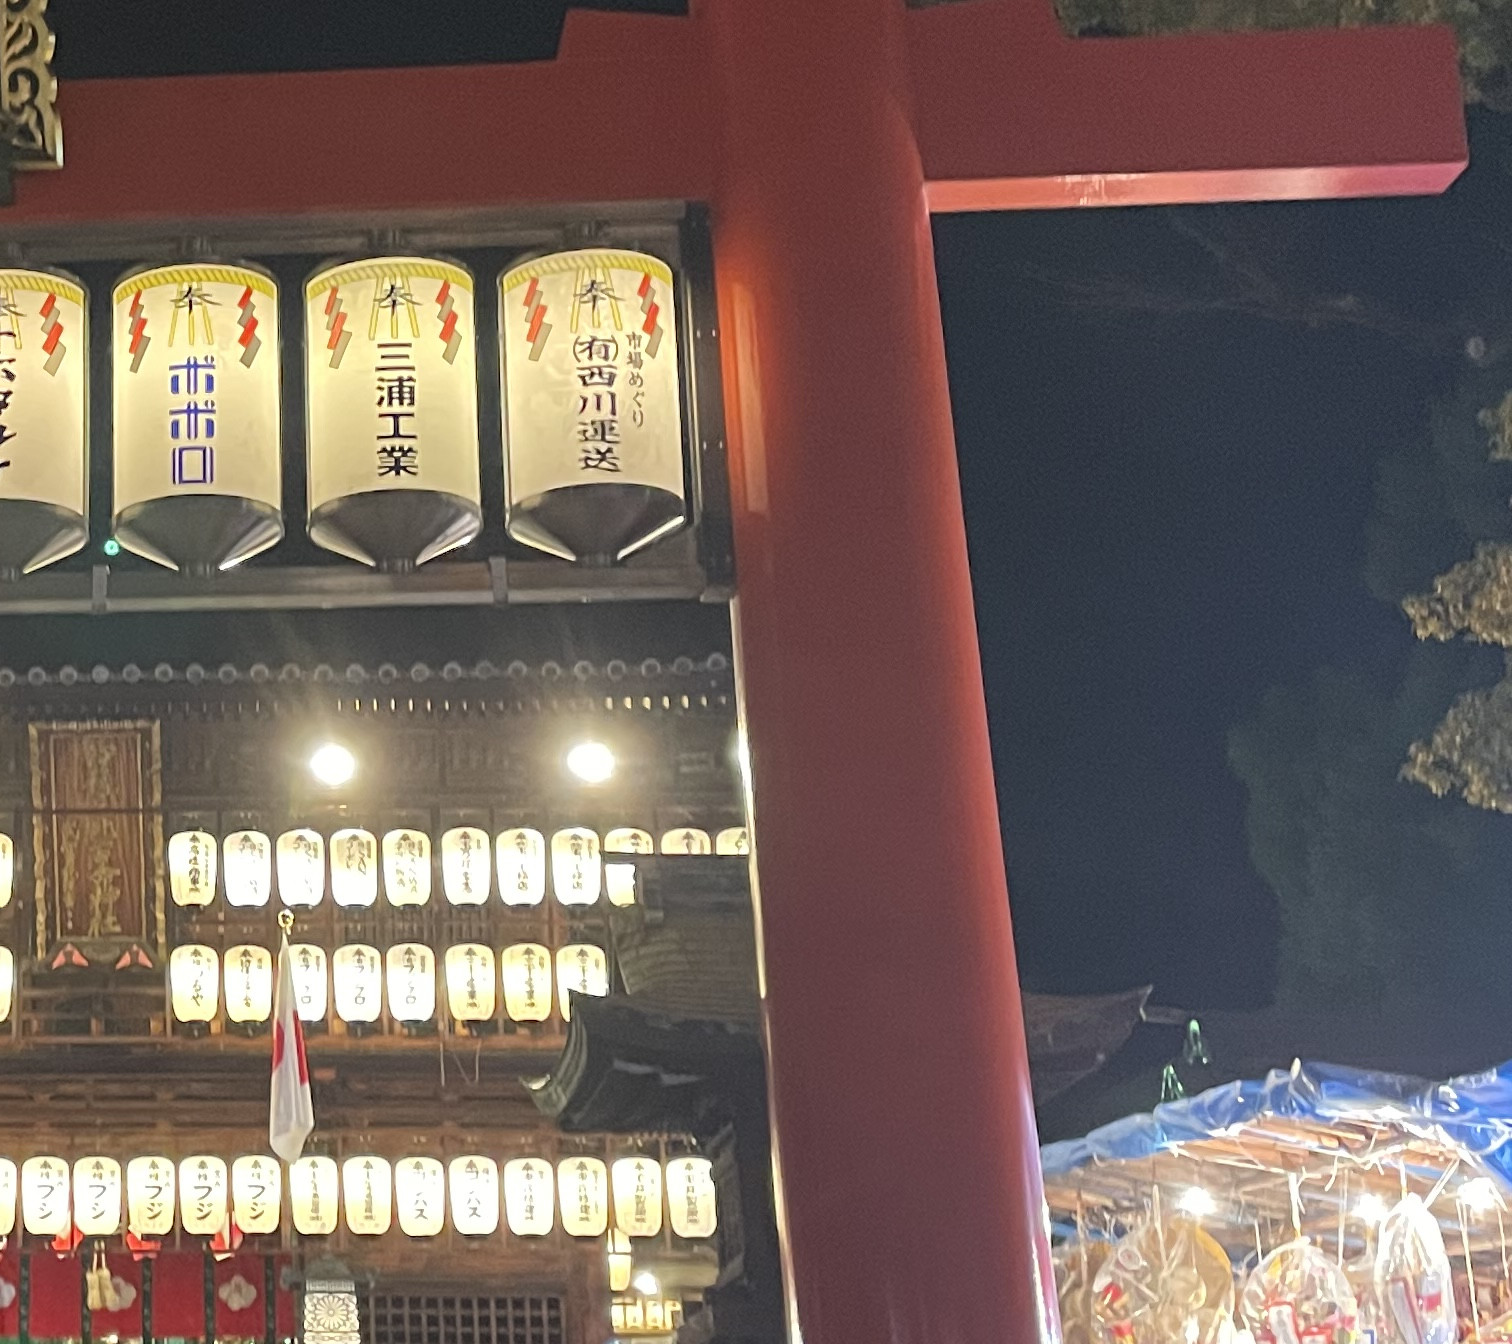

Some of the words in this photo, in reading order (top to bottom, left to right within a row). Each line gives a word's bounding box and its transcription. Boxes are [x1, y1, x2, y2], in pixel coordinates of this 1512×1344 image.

[374, 342, 419, 477] 三浦工業
[626, 330, 645, 429] 市場めぐり
